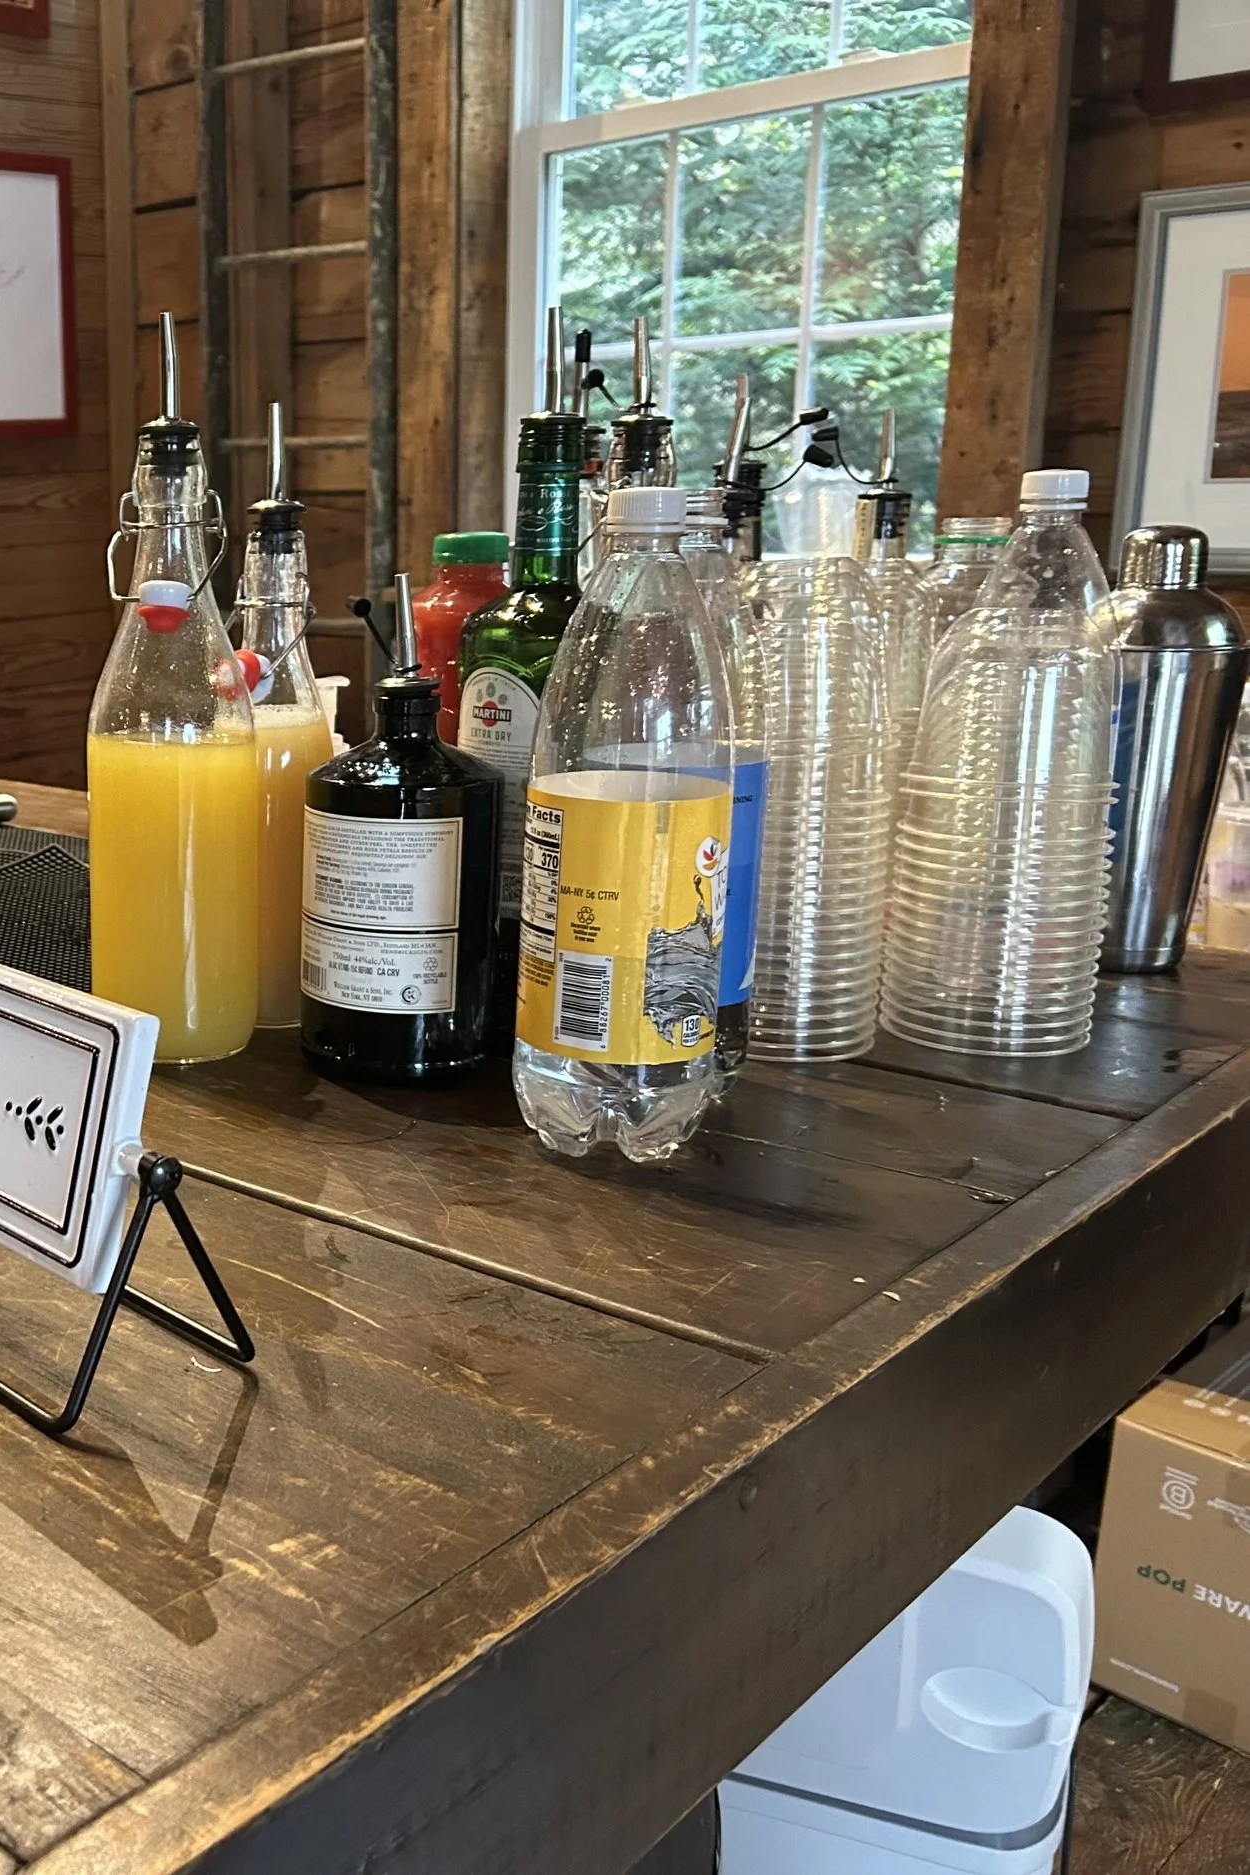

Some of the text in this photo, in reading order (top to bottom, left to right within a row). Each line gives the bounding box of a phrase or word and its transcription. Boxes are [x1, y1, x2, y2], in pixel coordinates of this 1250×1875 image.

[473, 706, 511, 721] MARTINI
[470, 727, 512, 742] EXTRA DRY
[532, 806, 561, 823] Facts
[541, 852, 558, 869] 370
[560, 885, 583, 897] MA-NY
[597, 890, 620, 901] CTRV
[601, 973, 611, 1002] 00081
[599, 1006, 609, 1033] 88267
[685, 1017, 699, 1031] 130
[1137, 1564, 1186, 1592] POP
